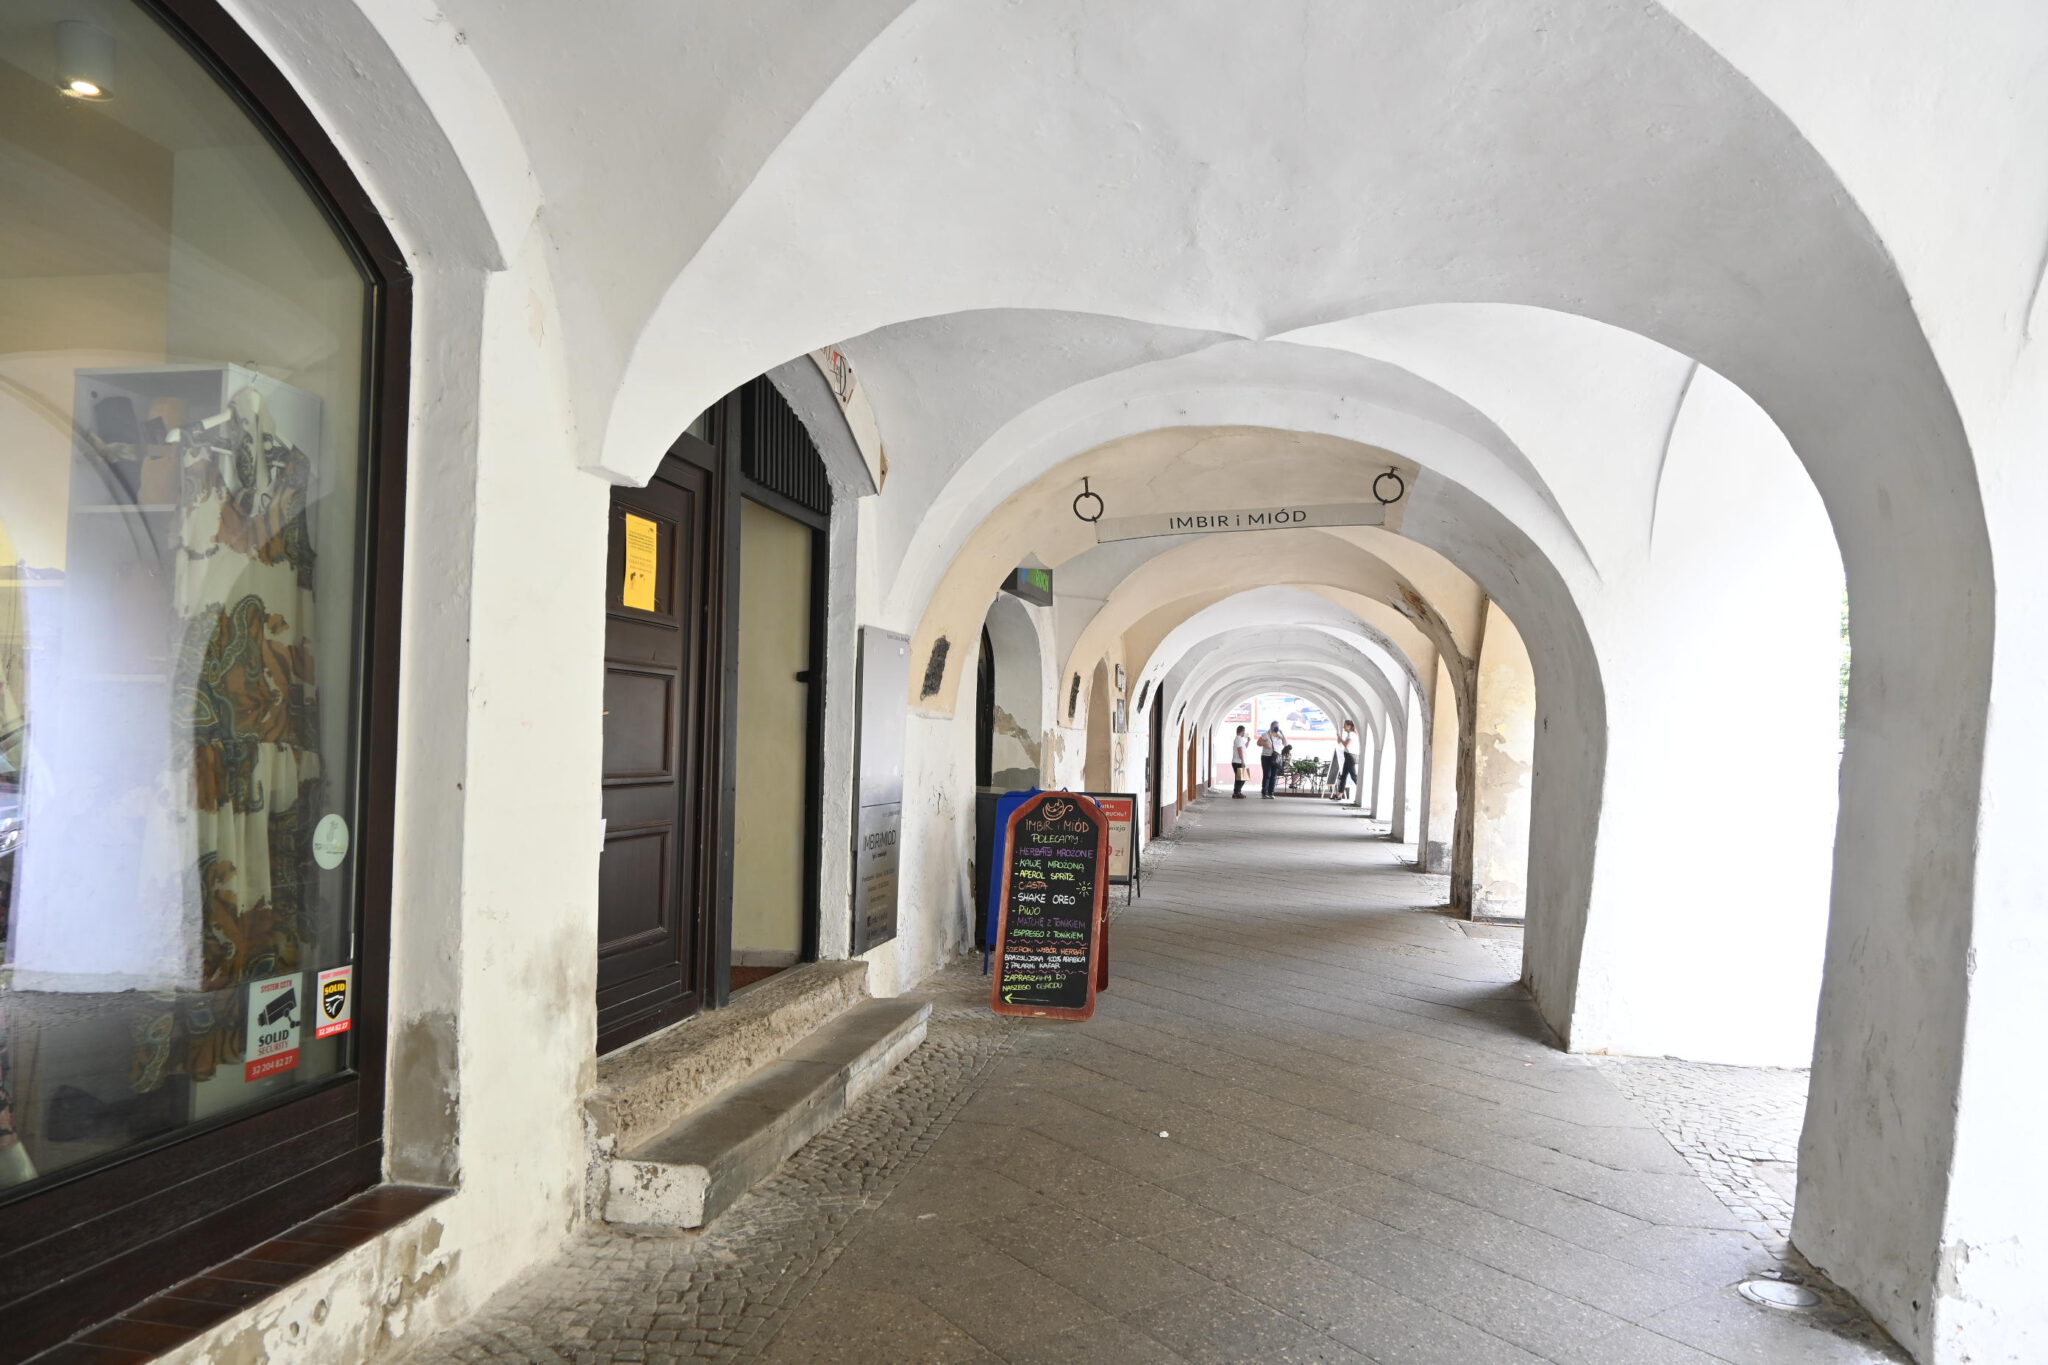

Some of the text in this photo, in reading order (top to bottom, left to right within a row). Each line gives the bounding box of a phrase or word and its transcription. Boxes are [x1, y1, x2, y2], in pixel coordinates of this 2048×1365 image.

[1170, 508, 1306, 529] IMBIR i MIÓD
[1020, 870, 1045, 880] APEROL
[1018, 892, 1076, 905] SHAKE OREO
[324, 983, 345, 995] SOLID
[259, 1029, 289, 1047] SOLID
[258, 1040, 289, 1056] SECURITY
